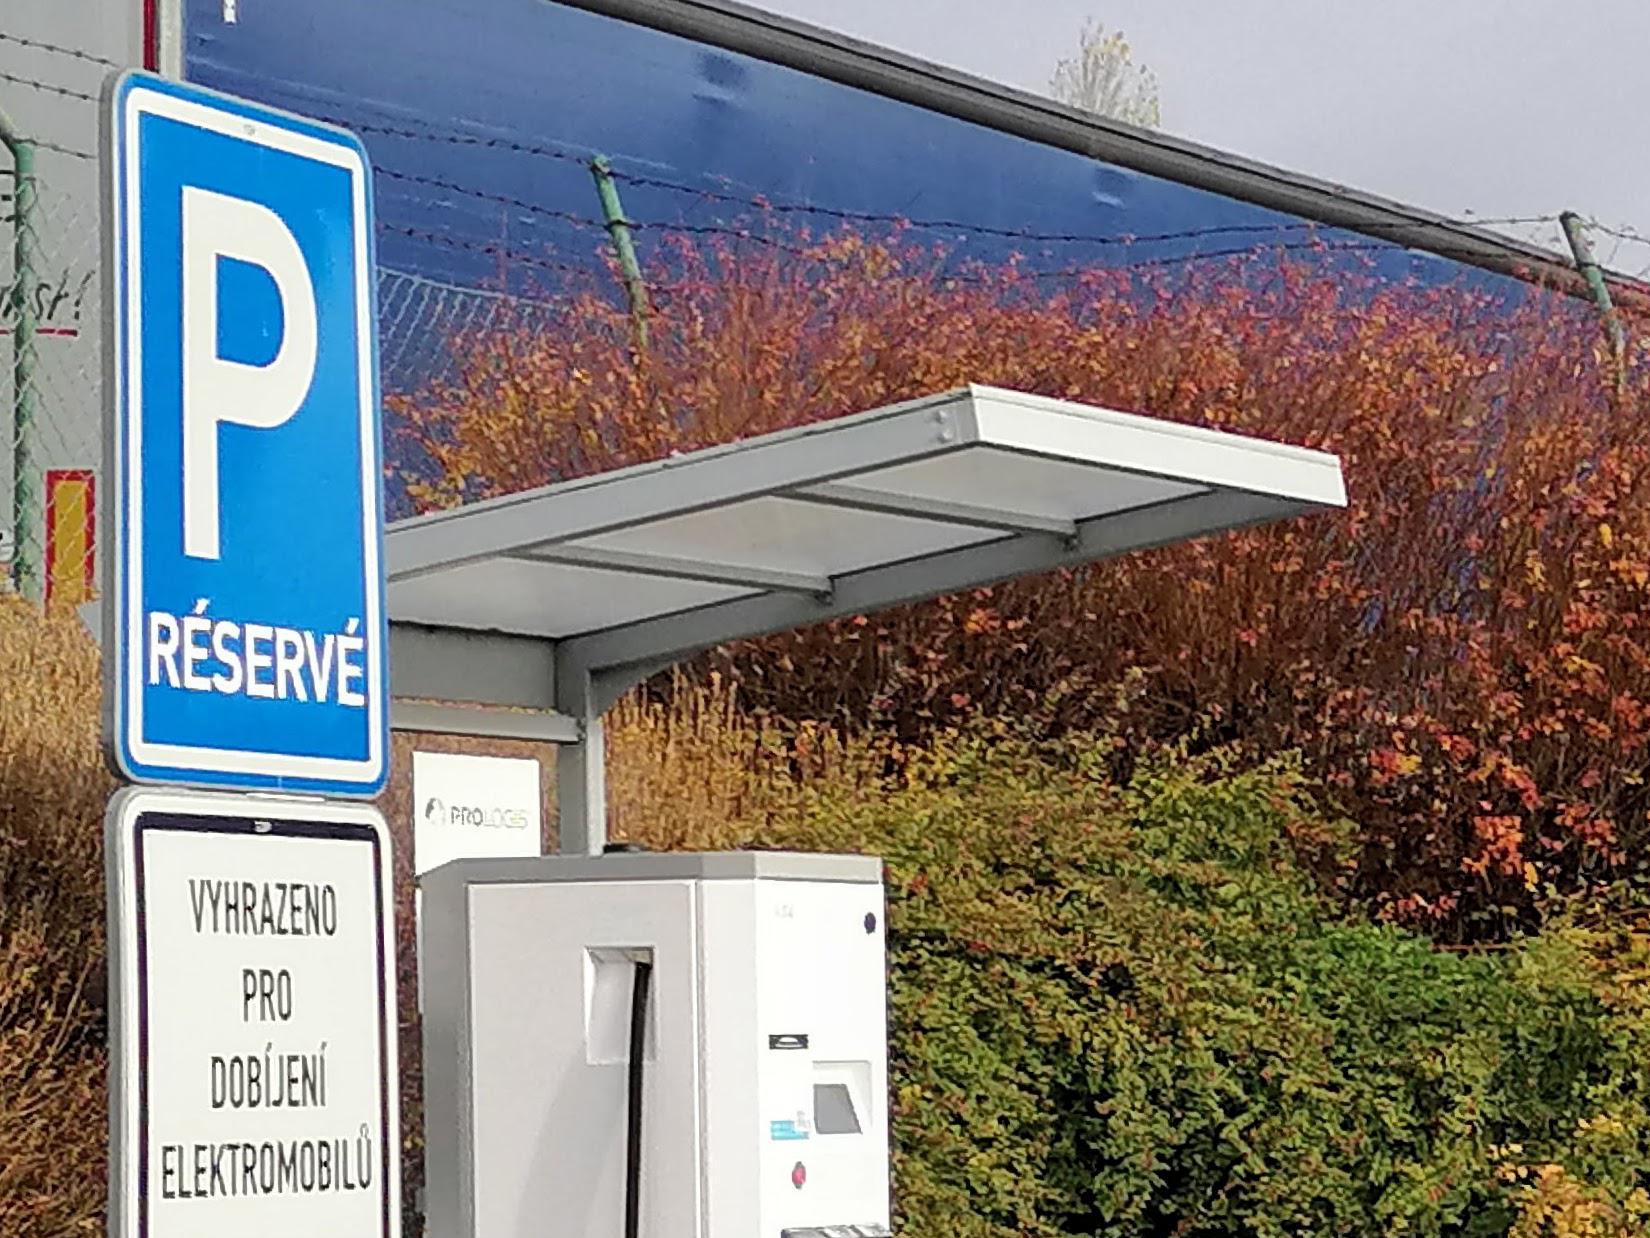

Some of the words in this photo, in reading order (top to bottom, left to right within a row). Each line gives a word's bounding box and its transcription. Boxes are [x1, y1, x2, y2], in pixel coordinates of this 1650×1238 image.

[181, 185, 318, 560] P
[149, 597, 365, 707] RÉSERVÉ
[188, 879, 337, 936] VYHRAZENO
[242, 968, 293, 1022] PRO
[211, 1041, 327, 1109] DOBÍJENÍ
[161, 1123, 372, 1199] ELEKTROMOBILŮ
